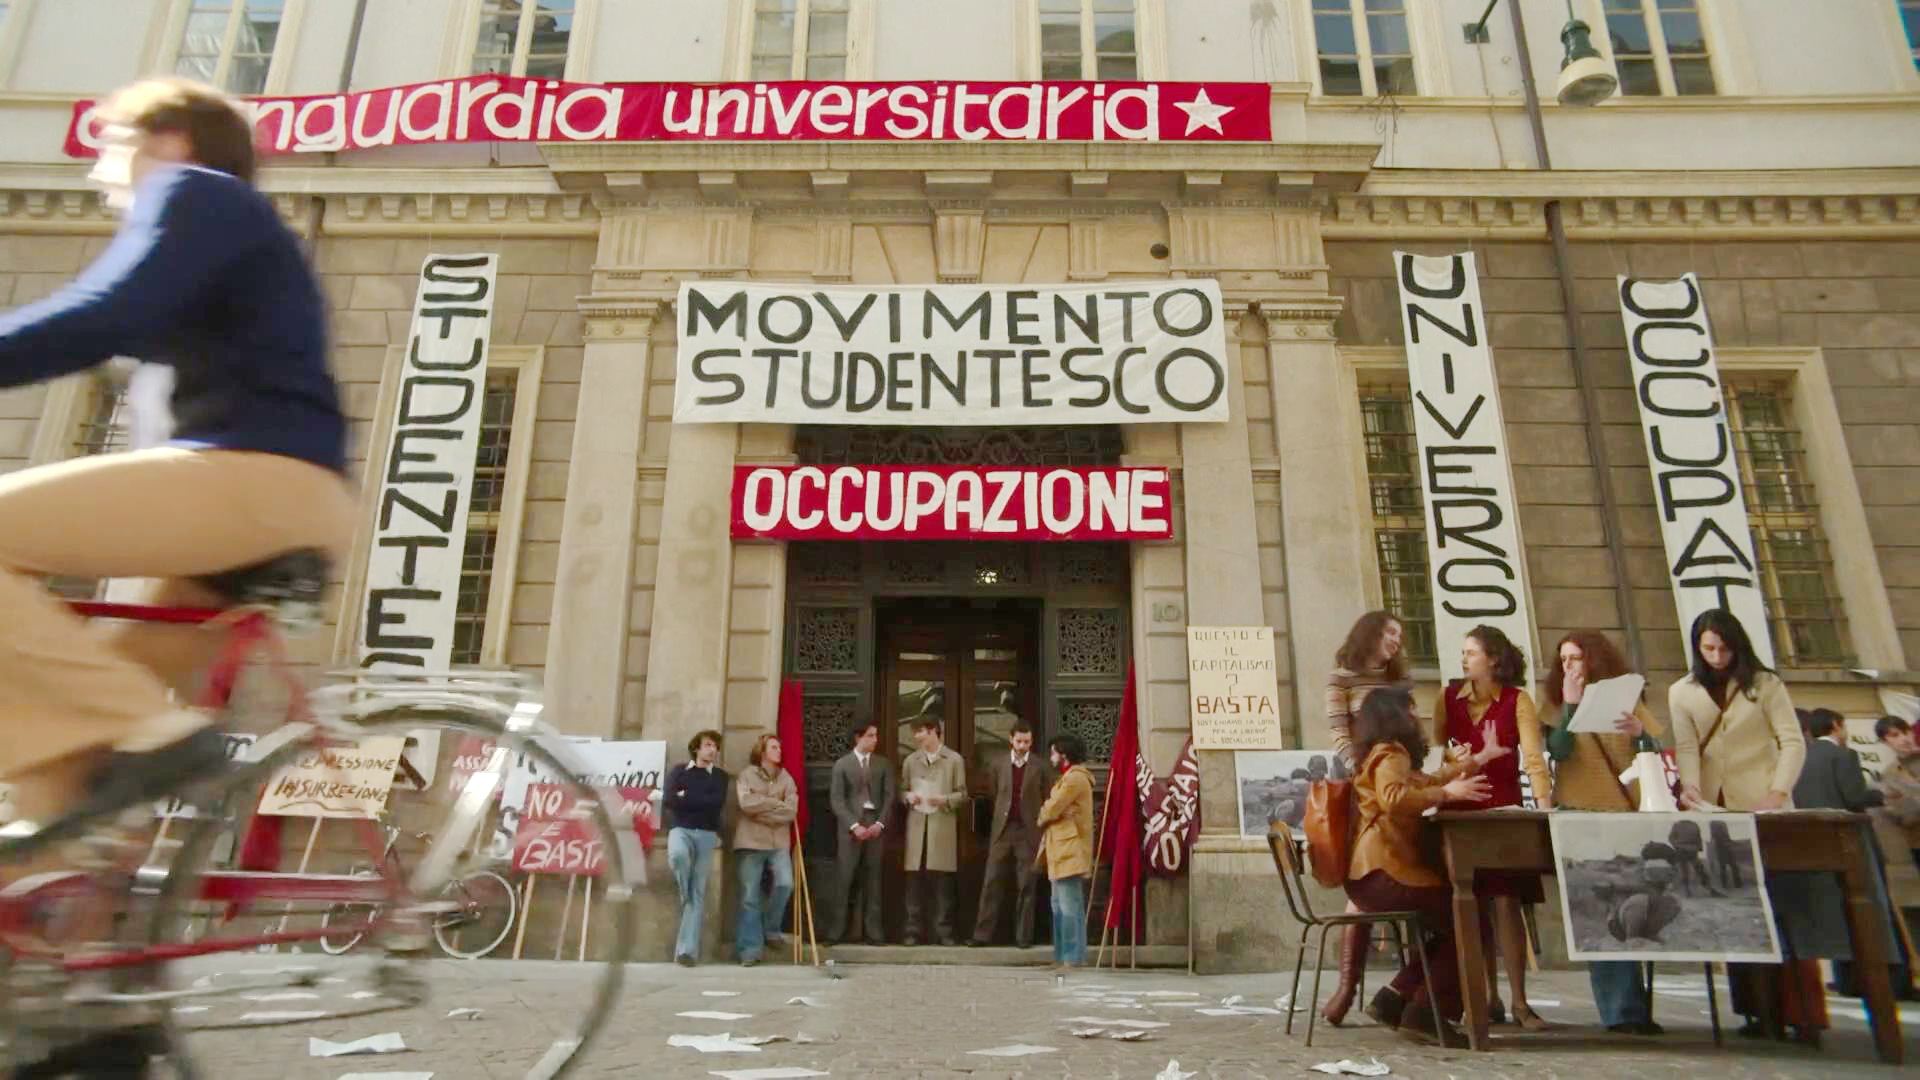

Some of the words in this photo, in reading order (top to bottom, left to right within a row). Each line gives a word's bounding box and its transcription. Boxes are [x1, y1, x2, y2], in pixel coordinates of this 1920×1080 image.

[76, 79, 623, 152] nguardia
[663, 82, 1160, 141] universitaria
[687, 287, 1213, 345] MOVIMENTO
[691, 346, 1225, 414] STUDENTESCO
[1401, 254, 1517, 618] UNIVERS
[1620, 277, 1754, 612] OCCUPAT
[743, 466, 1169, 534] OCCUPAZIONE
[1192, 659, 1273, 671] CAPITALISMO
[1224, 646, 1240, 656] IL
[1196, 695, 1274, 714] BASTA
[527, 785, 564, 820] NO
